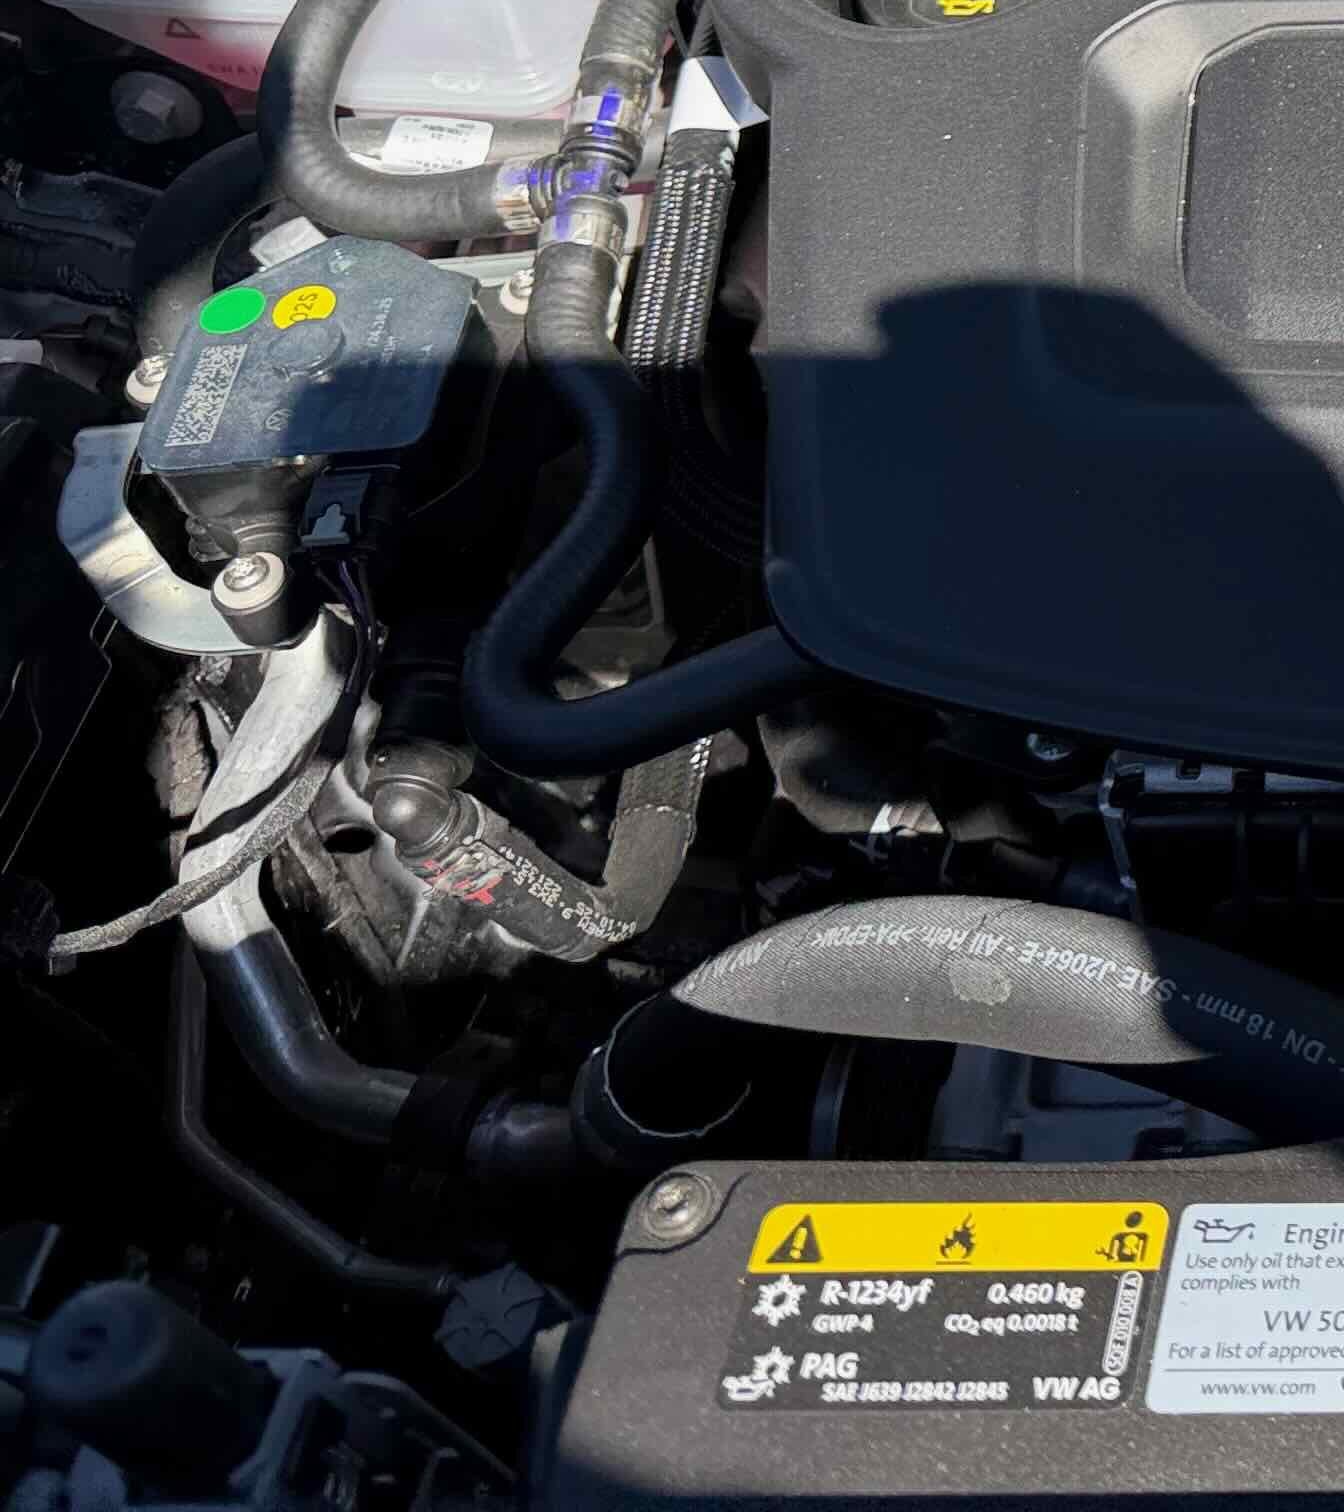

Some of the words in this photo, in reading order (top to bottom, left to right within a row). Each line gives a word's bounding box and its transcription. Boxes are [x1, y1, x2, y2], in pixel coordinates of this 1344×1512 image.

[1119, 965, 1177, 1002] SAE
[1281, 1028, 1326, 1063] DN
[1185, 1254, 1218, 1269] Use
[1221, 1254, 1258, 1273] only
[1262, 1253, 1282, 1269] oil
[1286, 1253, 1321, 1269] that
[1181, 1276, 1257, 1292] complies
[1262, 1276, 1300, 1290] with
[820, 1278, 934, 1312] R-1234yf
[988, 1282, 1054, 1304] 0.460
[1055, 1282, 1086, 1310] kg
[981, 1317, 1006, 1336] eq
[1264, 1309, 1311, 1332] VW
[1168, 1342, 1197, 1359] For
[1200, 1346, 1211, 1359] a
[1215, 1342, 1242, 1359] list
[1247, 1342, 1267, 1359] of
[800, 1352, 859, 1378] PAG
[821, 1381, 858, 1402] SAE
[1033, 1377, 1077, 1399] VW
[1076, 1377, 1120, 1399] AG
[1200, 1378, 1316, 1395] www.vw.com
